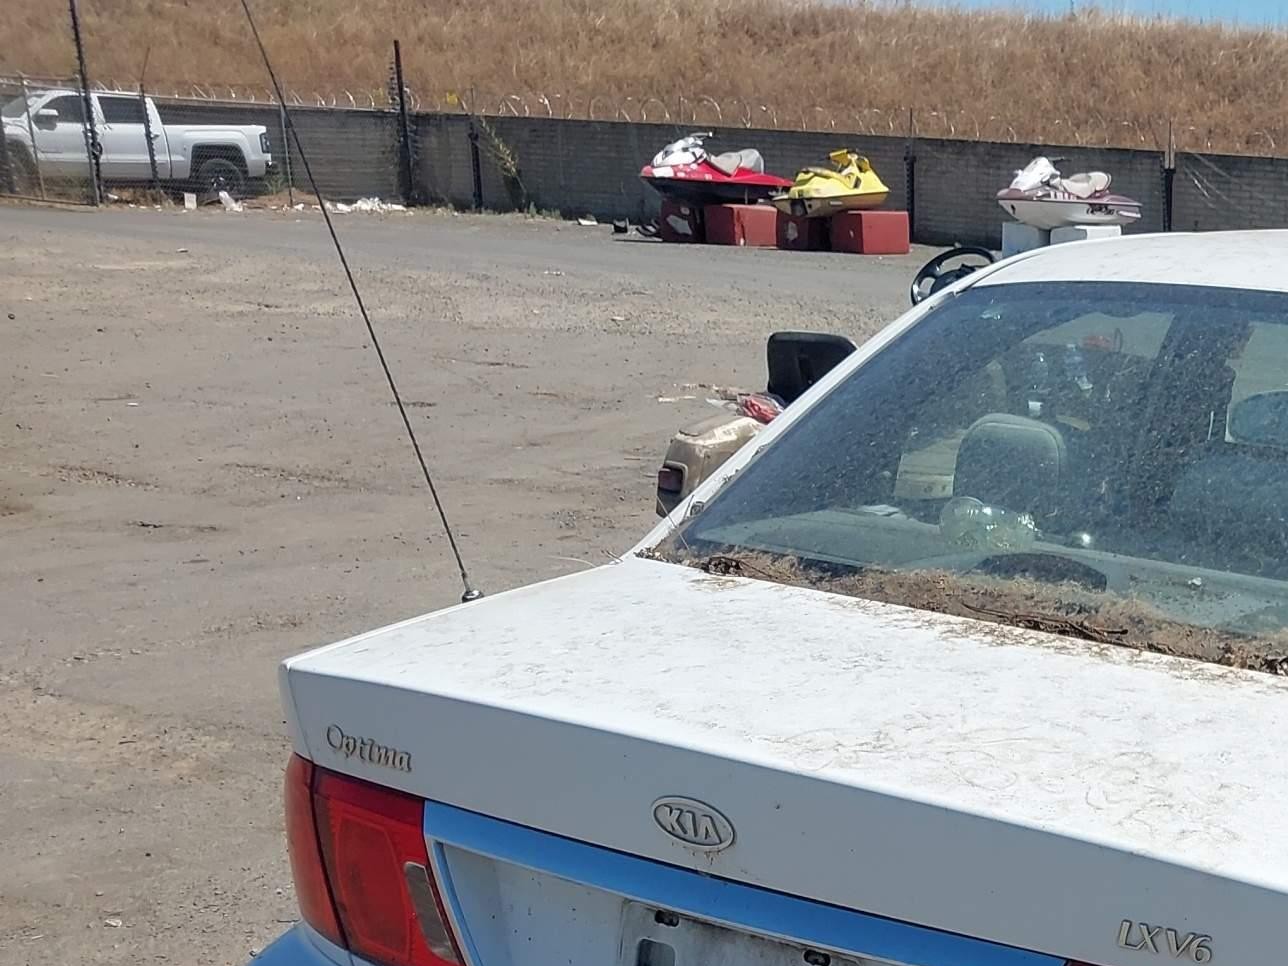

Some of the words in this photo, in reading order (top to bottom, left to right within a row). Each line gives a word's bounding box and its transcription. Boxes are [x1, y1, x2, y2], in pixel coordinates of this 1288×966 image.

[326, 723, 412, 773] Optima
[661, 803, 722, 844] KIA
[1118, 919, 1162, 954] LX
[1165, 927, 1213, 964] V6
